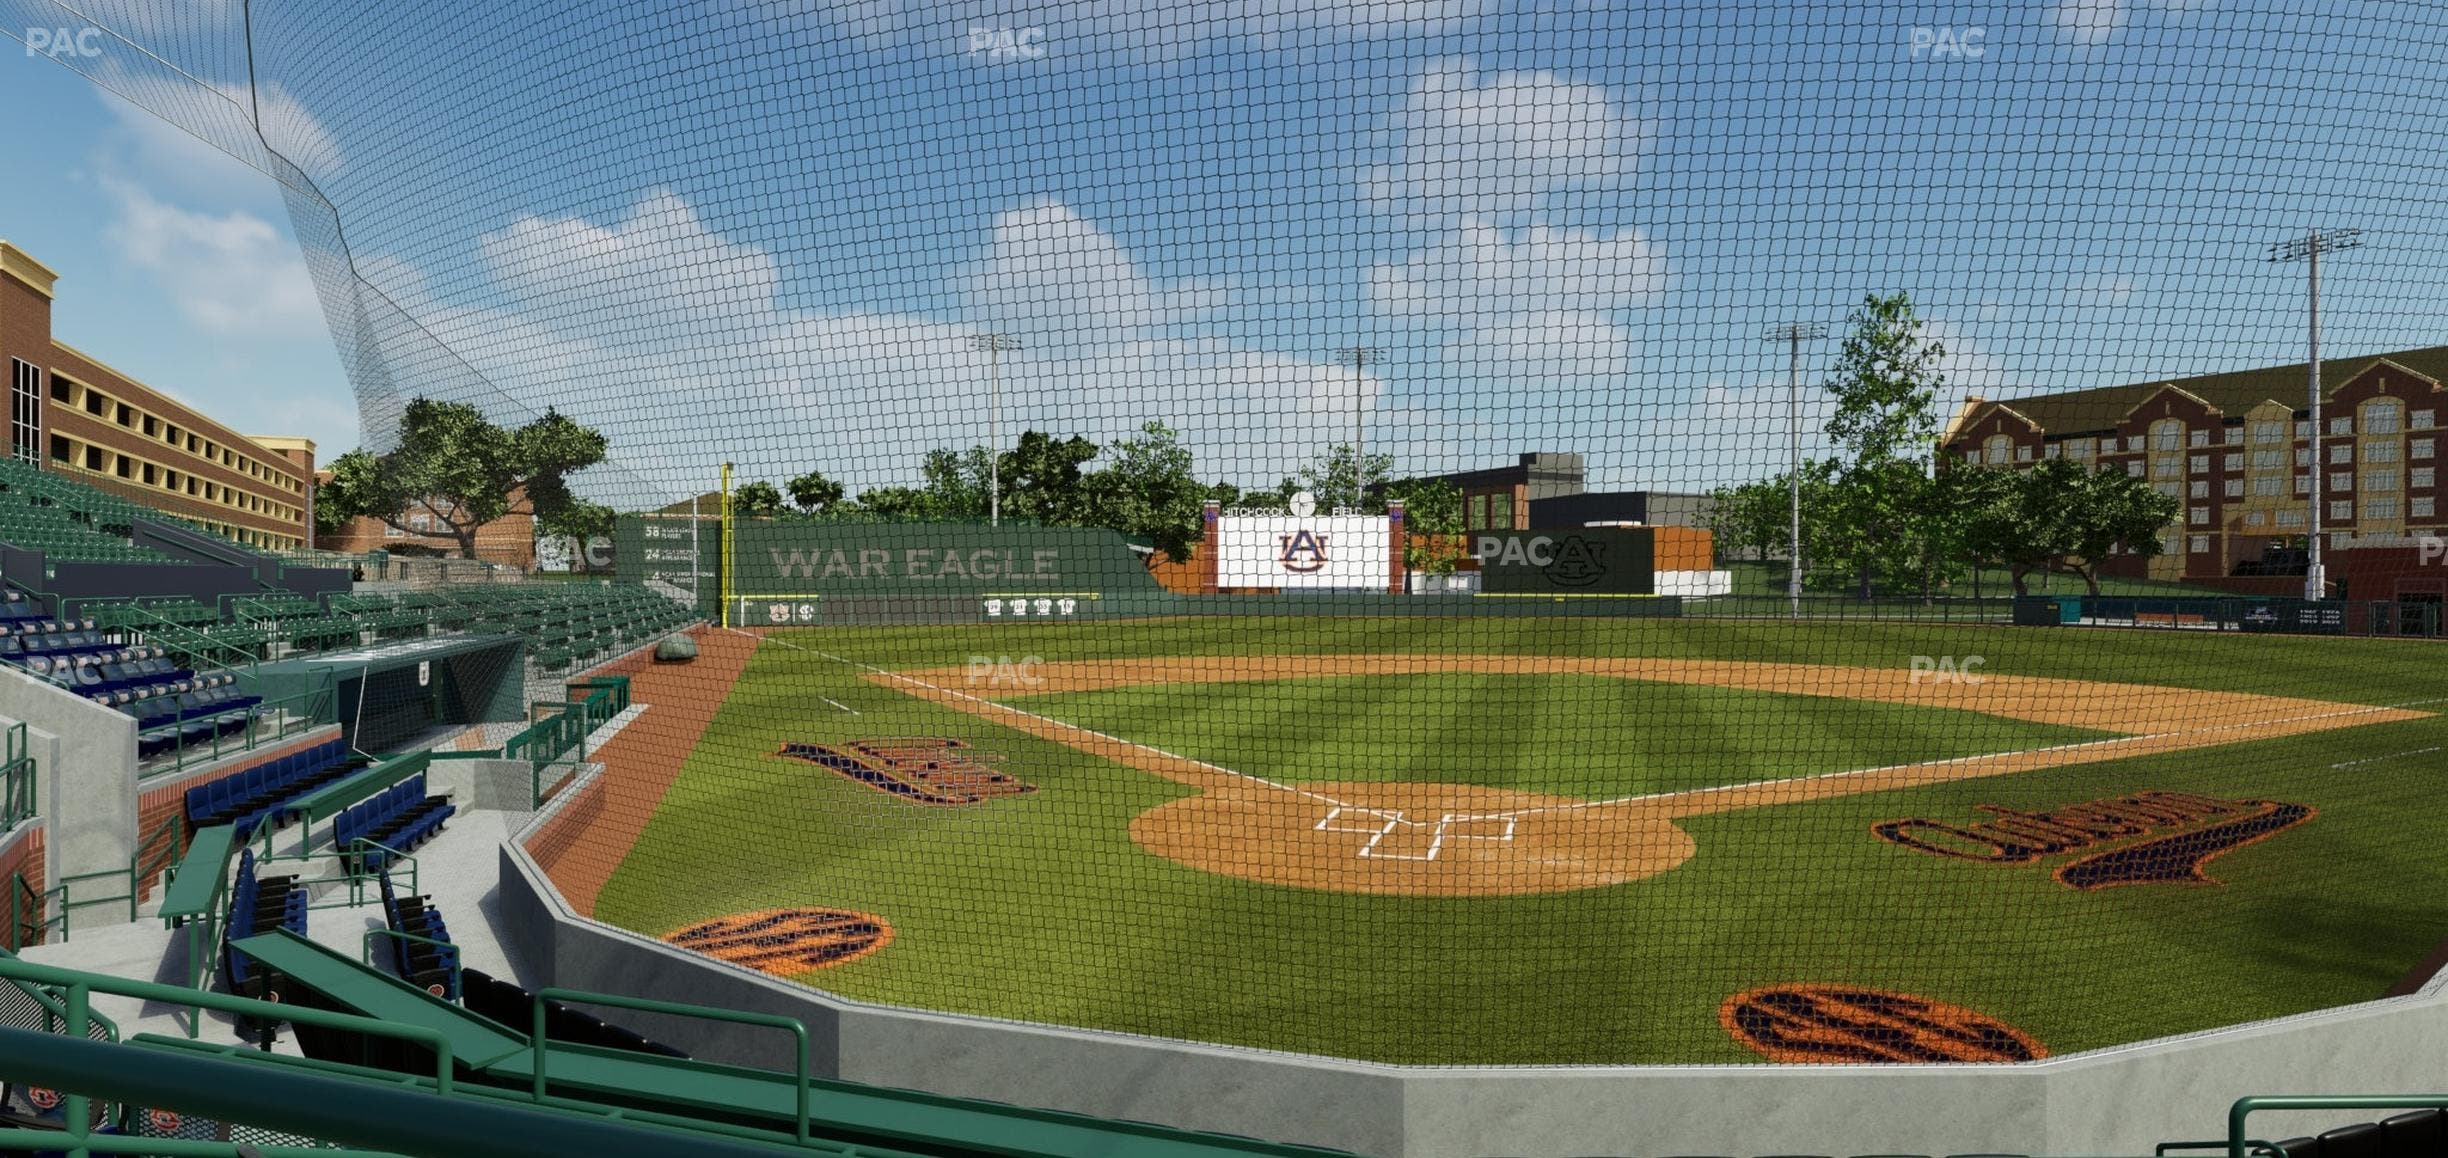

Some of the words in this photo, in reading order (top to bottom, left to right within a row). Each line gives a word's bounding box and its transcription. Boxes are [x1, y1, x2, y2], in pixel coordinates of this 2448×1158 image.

[1223, 506, 1286, 517] HITCHCOCK
[645, 526, 660, 537] 58
[769, 547, 891, 579] WAR
[905, 548, 1059, 580] EAGLE
